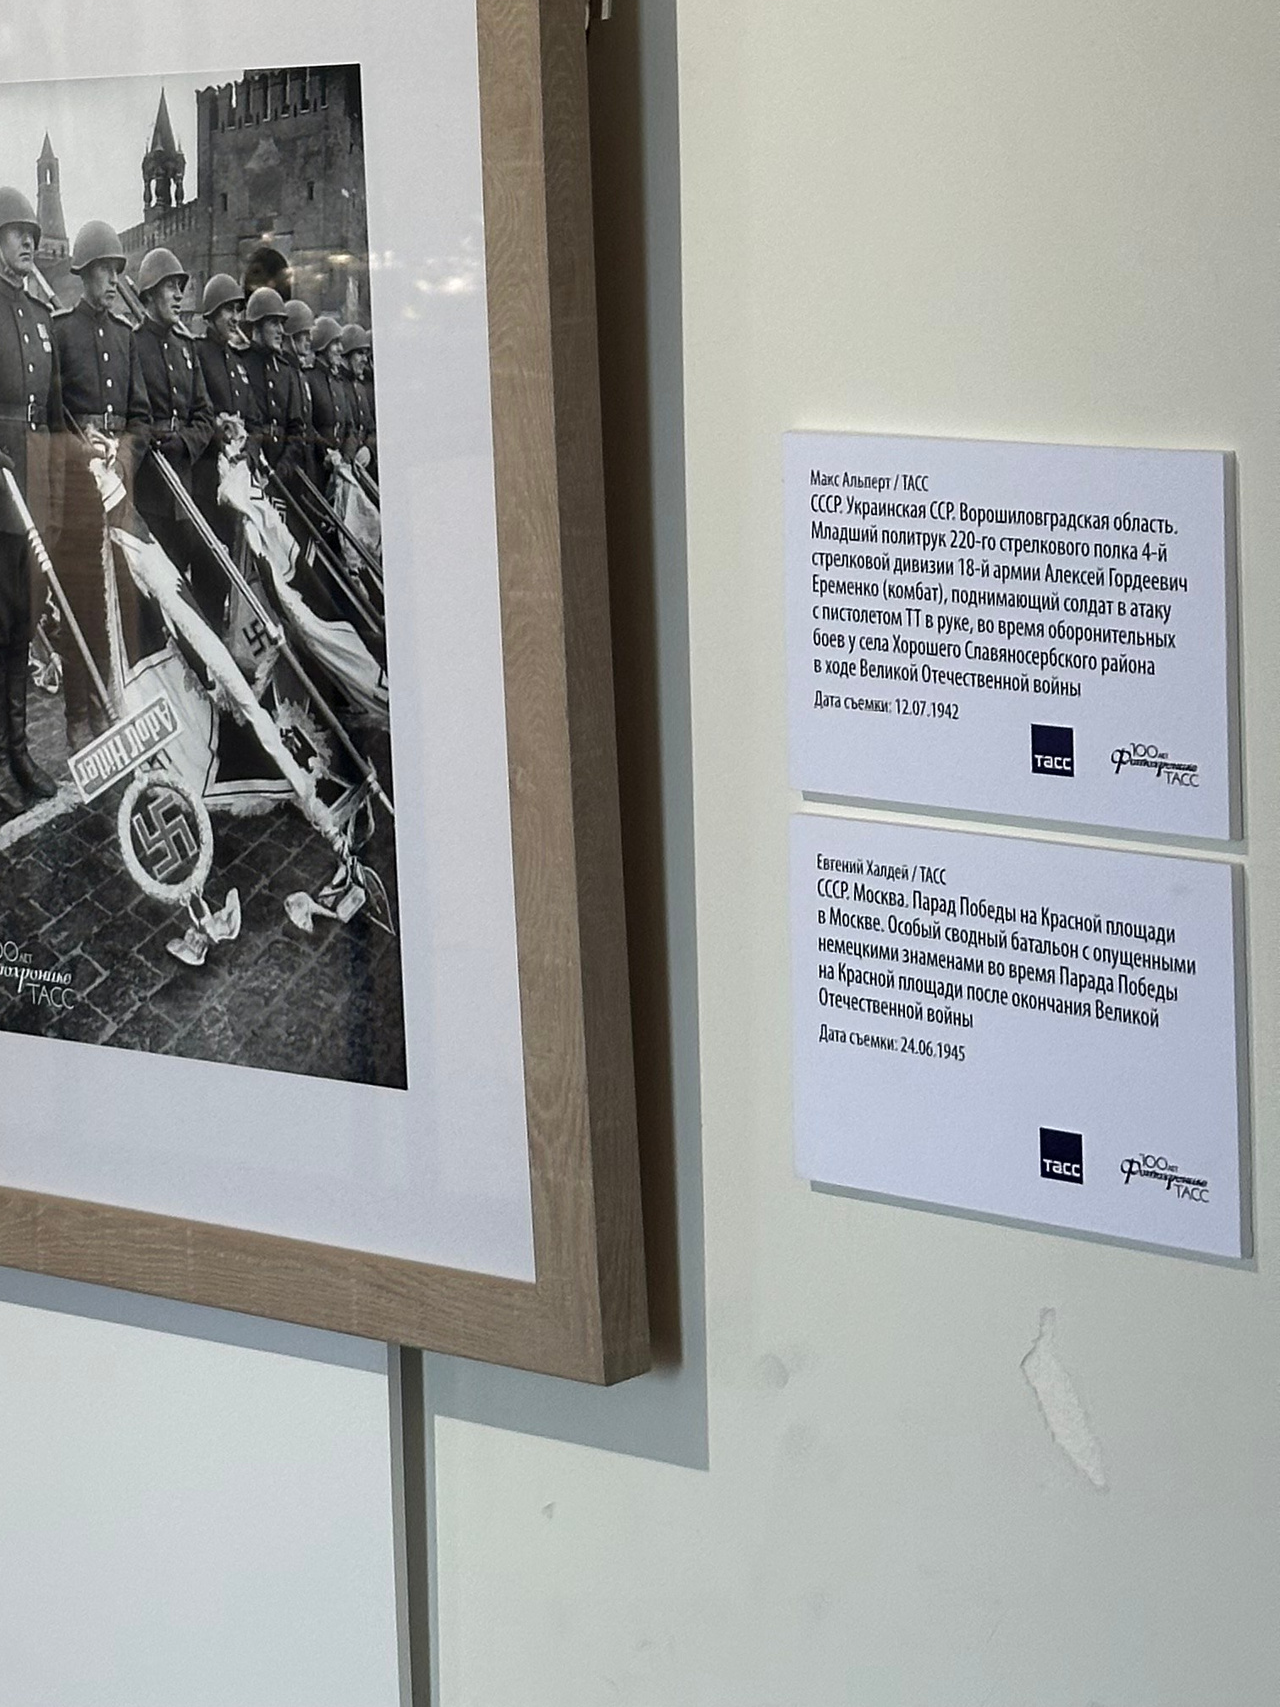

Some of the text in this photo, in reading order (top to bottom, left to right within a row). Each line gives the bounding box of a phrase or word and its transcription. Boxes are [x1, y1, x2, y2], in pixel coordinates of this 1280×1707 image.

[809, 468, 929, 497] Макс Альперт / ТАСС
[810, 493, 1177, 534] СССР. Украинская ССР. Ворошиловградская область.
[811, 520, 1167, 562] Младший политрук 220-го стрелкового полка 4-й
[811, 551, 1187, 594] стрелковой дивизии 18-й армии Алексей Гордеевич
[812, 573, 1171, 625] Еременко (комбат), поднимающий солдат в атаку
[812, 605, 1175, 648] с пистолетом ТТ в руке, во время оборонительных
[812, 627, 1154, 676] боев у села Хорошего Славяносербского района
[813, 657, 1080, 696] в ходе Великой Отечественной войны
[813, 689, 959, 720] Дата съемки: 12.07.1942
[1164, 771, 1199, 787] ТАСС
[816, 852, 946, 885] Евгений Халдей / ТАСС
[816, 877, 1175, 946] СССР. Москва. Парад Победы на Красной площади
[817, 905, 1195, 975] в Москве. Особый сводный батальон с опущенными
[818, 936, 1177, 1002] немецкими знаменами во время Парада Победы
[26, 983, 74, 1009] ТАСС
[818, 961, 1158, 1027] на Красной площади после окончания Великой
[818, 986, 973, 1028] Отечественной войны
[818, 1023, 965, 1061] Дата съемки: 24.06.1945
[1174, 1184, 1209, 1203] ТАСС
